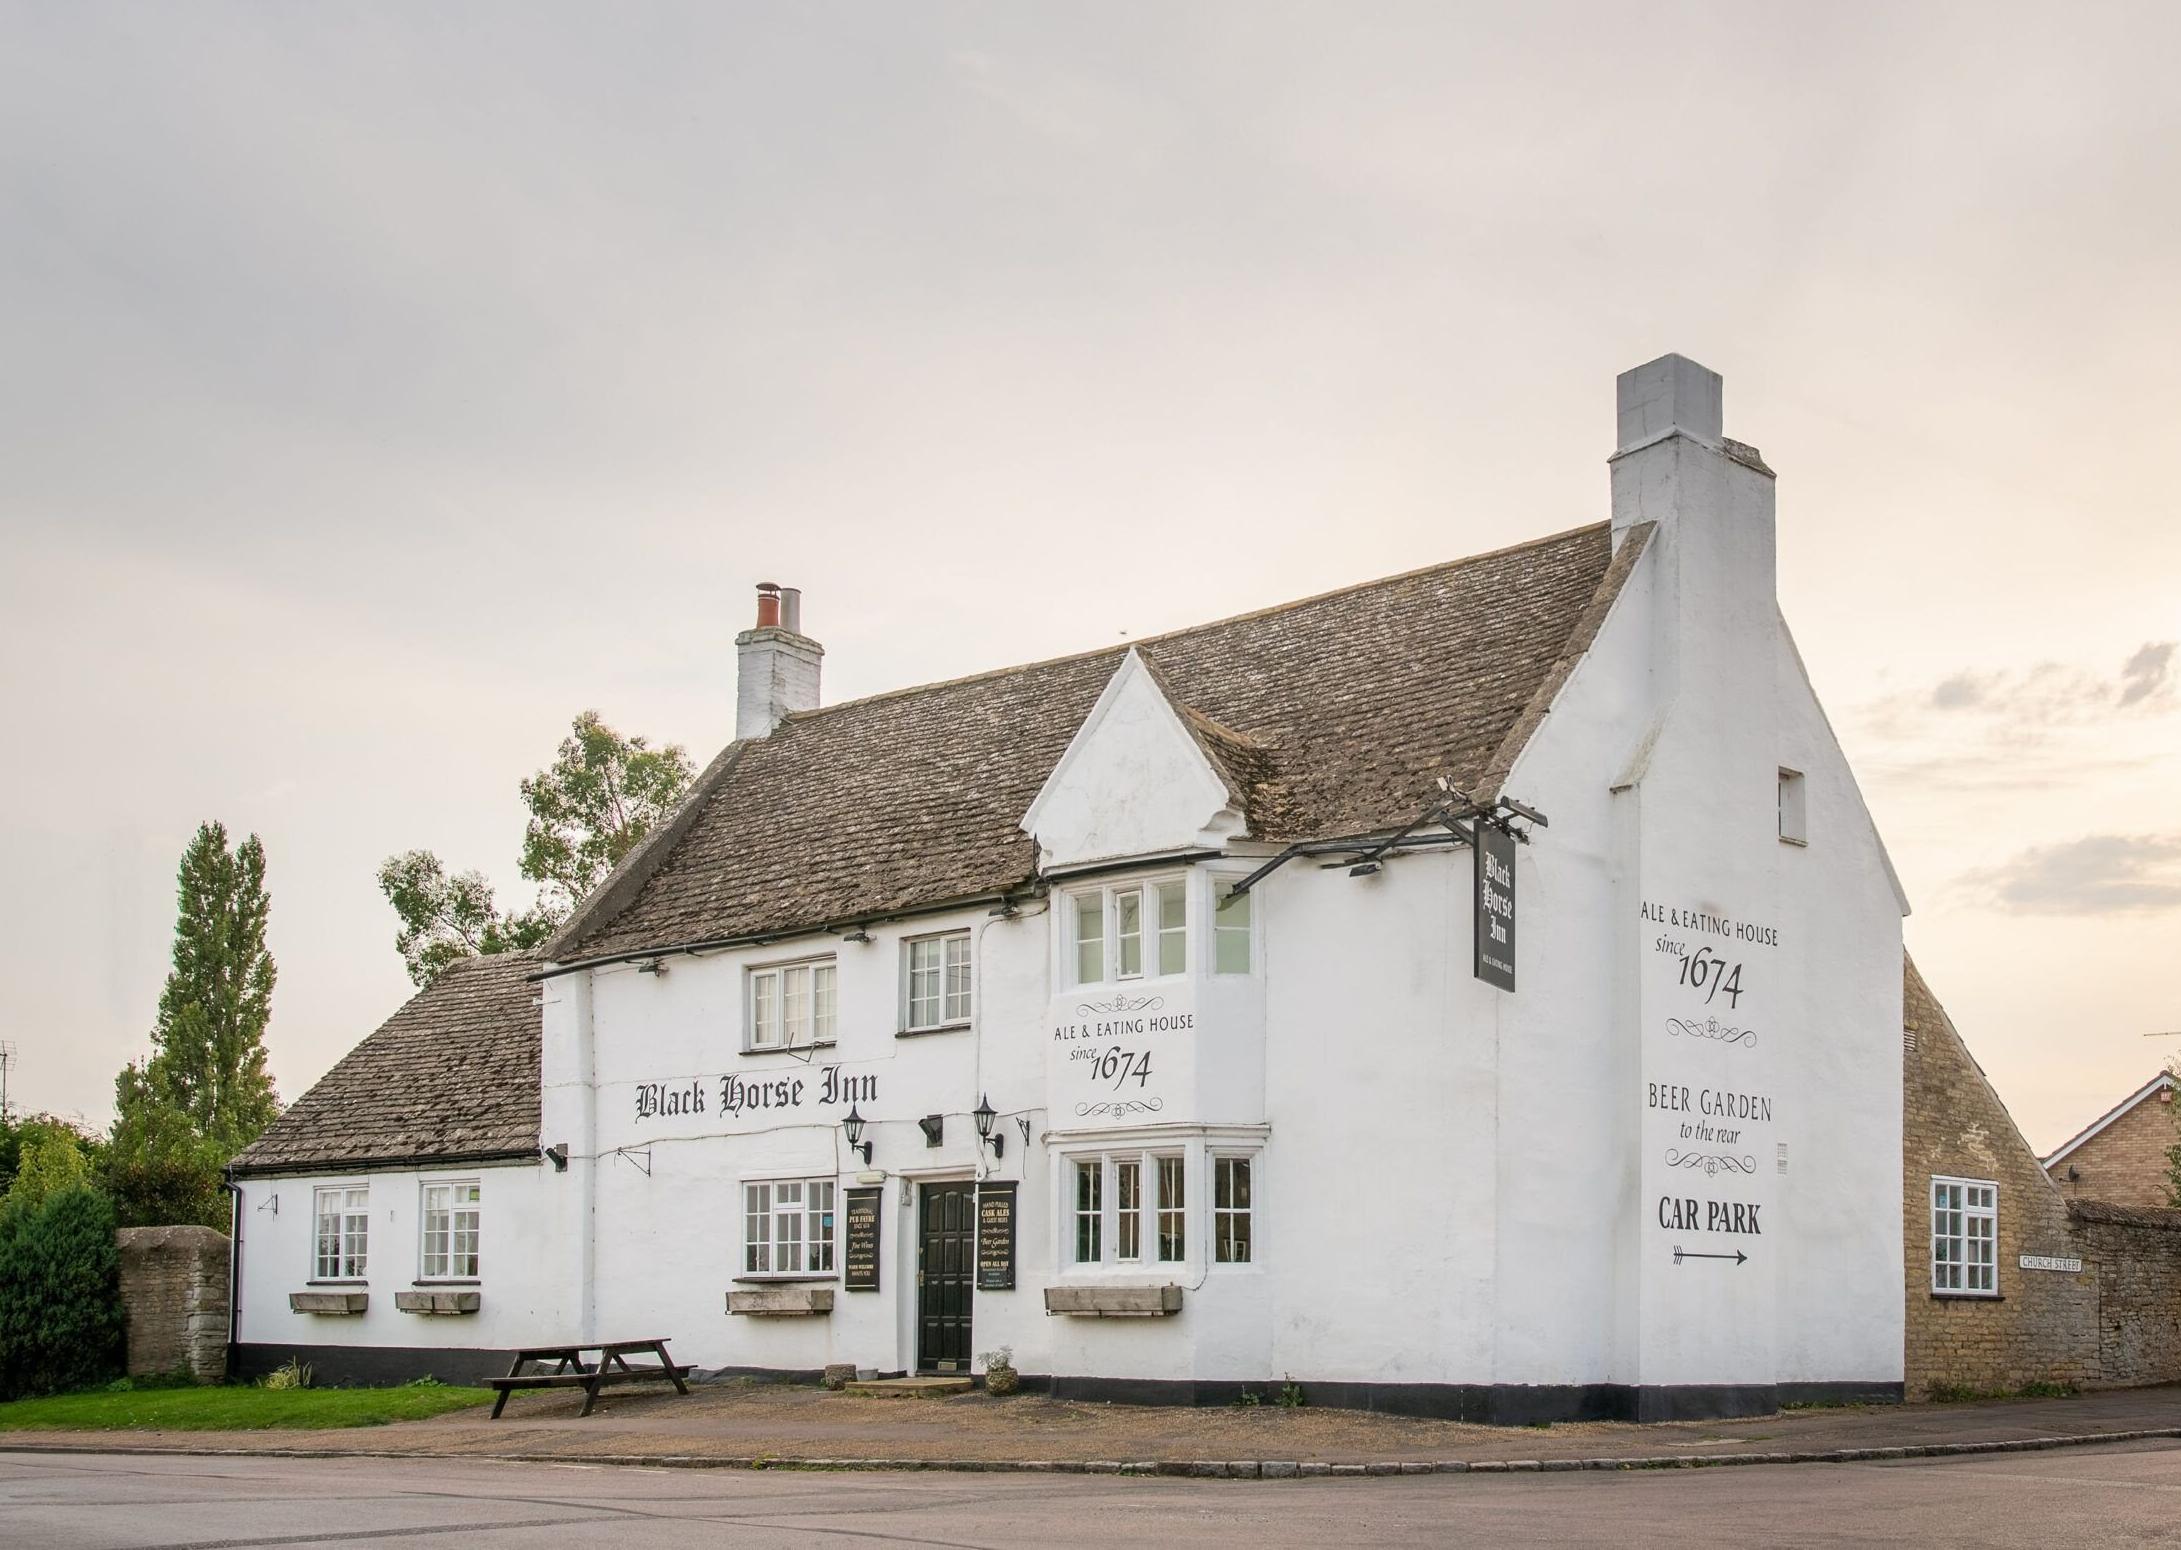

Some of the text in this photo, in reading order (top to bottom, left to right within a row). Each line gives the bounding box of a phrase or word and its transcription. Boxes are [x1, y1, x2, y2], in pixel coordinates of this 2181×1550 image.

[1485, 851, 1511, 889] Black
[1482, 879, 1512, 920] Horse
[1490, 915, 1507, 944] Inn
[1640, 901, 1779, 947] ALE & EATING HOUSE
[1655, 934, 1744, 1009] since 1674
[1054, 1014, 1194, 1041] ALE & EATING HOUSE
[1069, 1045, 1153, 1092] since 1674
[635, 1064, 878, 1124] Black Horse Inn
[1648, 1083, 1772, 1122] BEER GARDEN
[1680, 1120, 1741, 1145] to the rear
[849, 1215, 859, 1223] PUB
[981, 1208, 1010, 1217] CASK ALES
[1659, 1195, 1762, 1235] CAR PARK
[2022, 1256, 2080, 1270] CHURCH STREET
